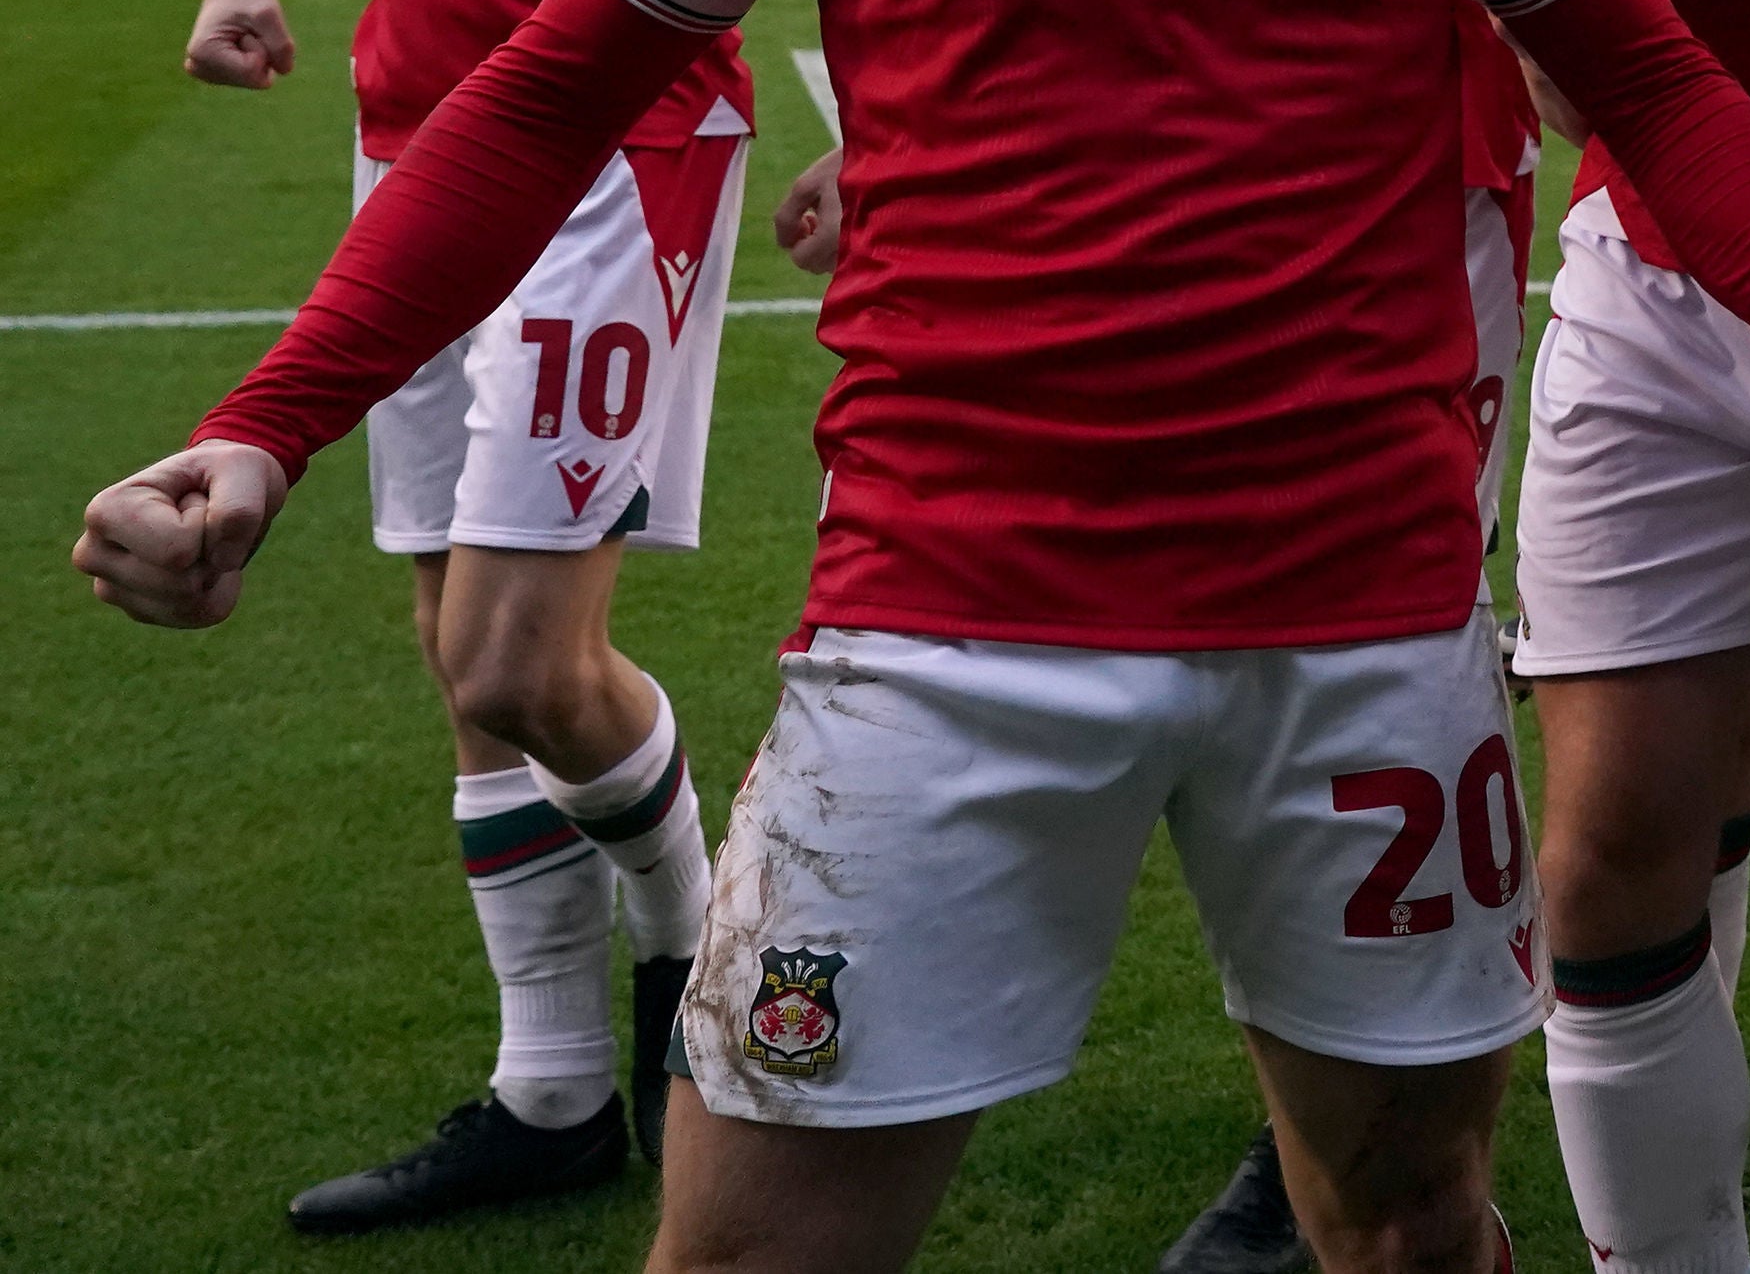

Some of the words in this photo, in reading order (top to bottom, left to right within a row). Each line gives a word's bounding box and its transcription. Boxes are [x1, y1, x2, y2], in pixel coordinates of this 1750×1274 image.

[521, 318, 651, 440] 10
[1330, 733, 1522, 937] 20
[1392, 924, 1412, 935] EFL
